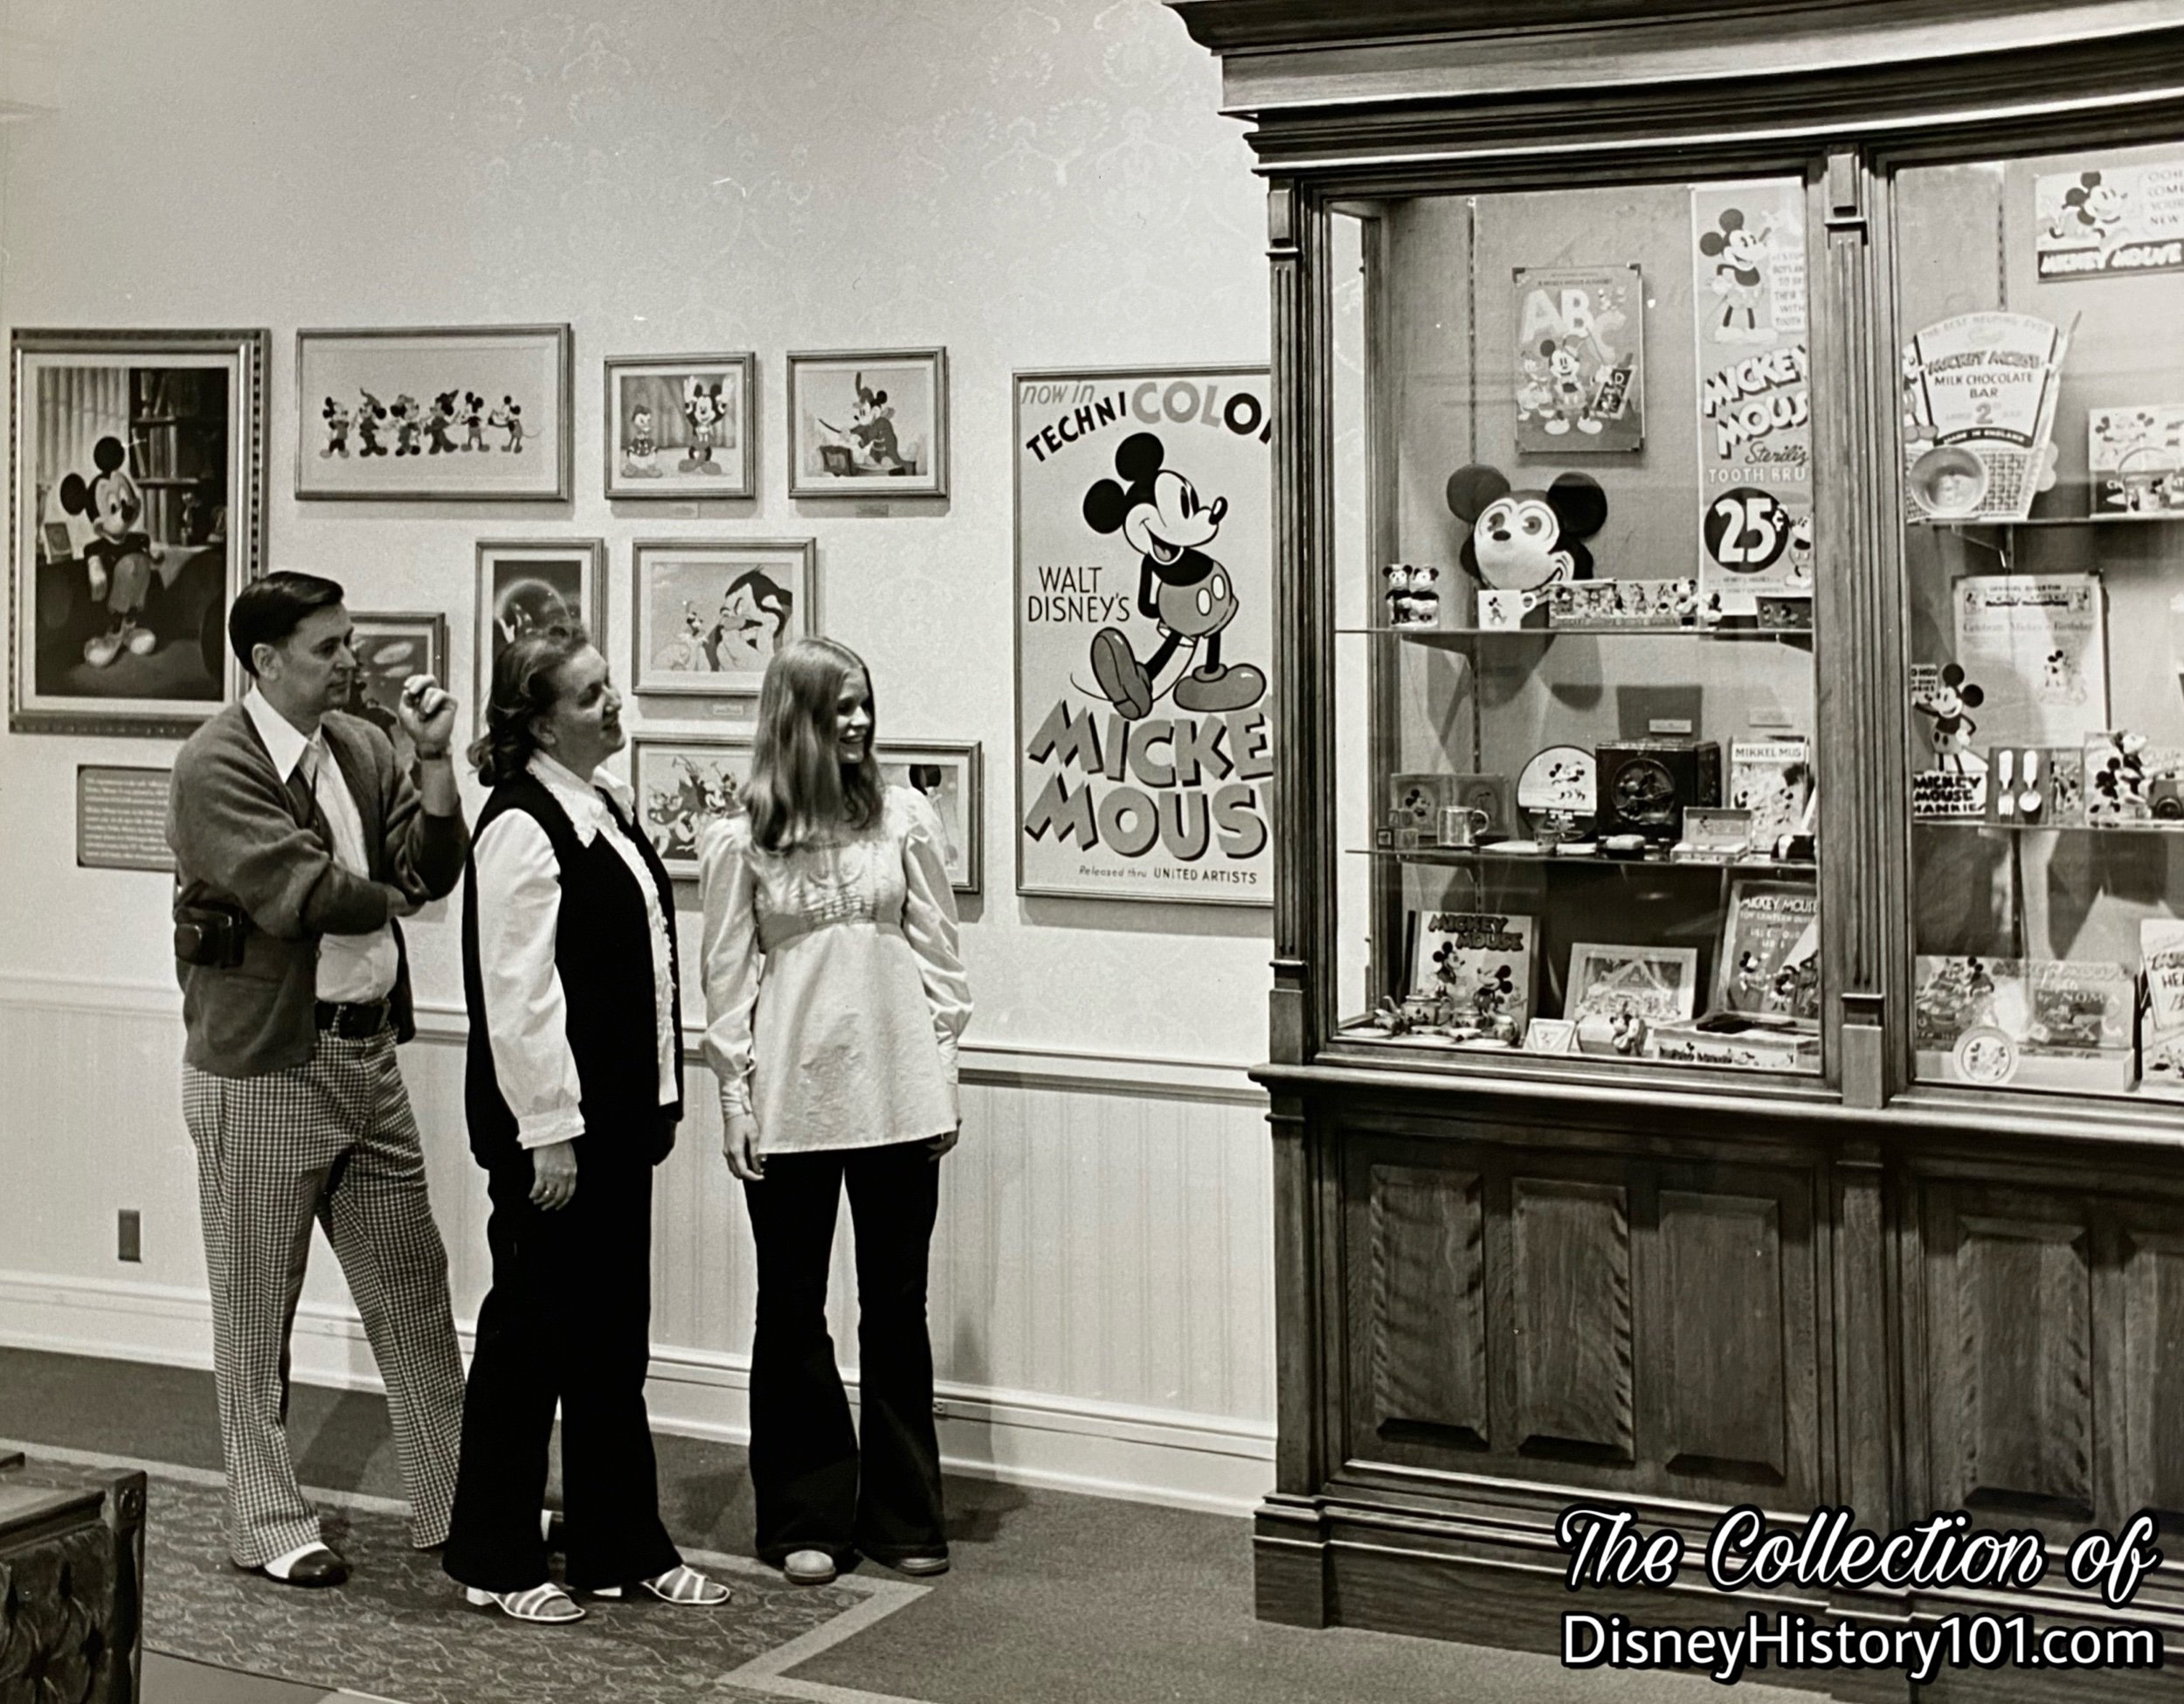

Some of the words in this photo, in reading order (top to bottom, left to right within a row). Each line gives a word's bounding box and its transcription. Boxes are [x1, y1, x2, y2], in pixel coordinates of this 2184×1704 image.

[1934, 375, 1963, 386] MILK
[1966, 372, 2033, 386] CHOCOLATE
[1021, 383, 1065, 405] now
[1071, 378, 1095, 404] in
[1969, 387, 1999, 398] BAR
[1026, 380, 1271, 462] TECHNICOLO
[1709, 468, 1764, 482] TOOTH
[1772, 468, 1806, 481] BRU
[1038, 565, 1102, 593] WALT
[1028, 592, 1130, 622] DISNEY'S
[1026, 696, 1273, 789] MICKE
[1735, 747, 1777, 758] MIKKEL
[1779, 748, 1801, 758] MUS
[1913, 775, 1982, 789] MICKEY
[1913, 789, 1974, 803] MOUSE
[1079, 864, 1124, 877] Released
[1127, 868, 1147, 878] thru
[1201, 869, 1257, 884] ARTISTS
[1739, 894, 1780, 911] MICKEY
[1428, 913, 1510, 932] MICKEY
[1455, 931, 1524, 952] MOUSE
[2060, 992, 2122, 1005] NOMA
